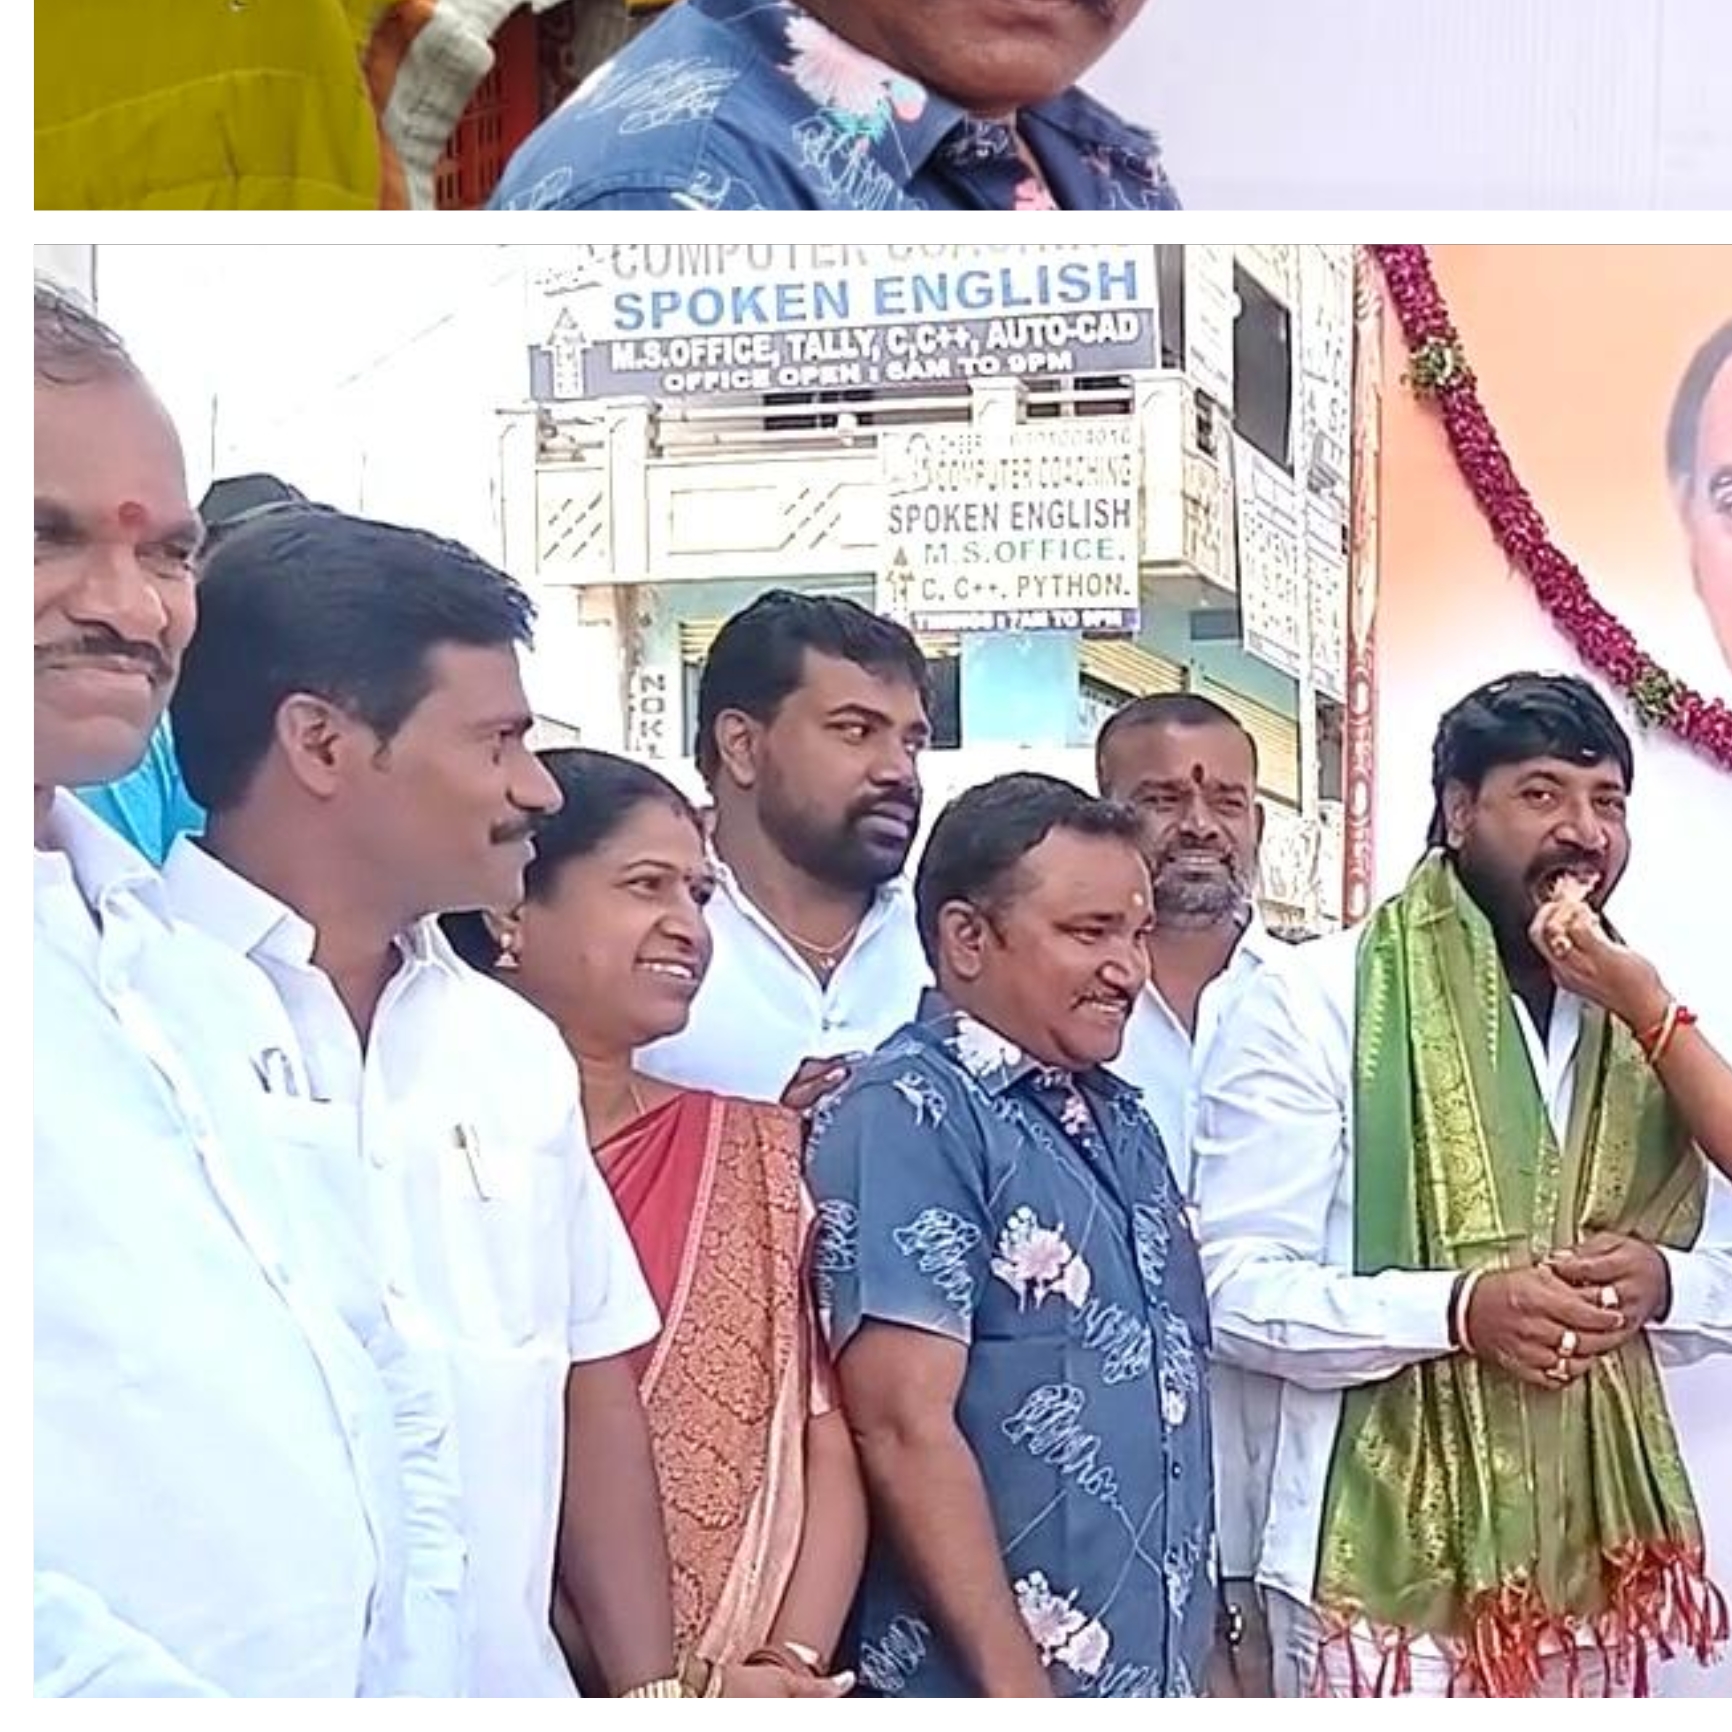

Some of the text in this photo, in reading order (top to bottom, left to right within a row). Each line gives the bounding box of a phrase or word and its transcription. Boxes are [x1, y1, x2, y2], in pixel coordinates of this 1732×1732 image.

[613, 259, 1138, 331] SPOKEN ENGLISH
[611, 333, 780, 370] M.S.OFFICE,
[787, 326, 881, 363] TALLY,
[986, 312, 1139, 350] AUTO-CAD
[663, 369, 771, 392] OFFICE
[777, 364, 860, 388] OPEN
[958, 354, 1001, 376] TO
[1007, 350, 1073, 373] 9PM
[888, 497, 1132, 535] SPOKEN ENGLISH
